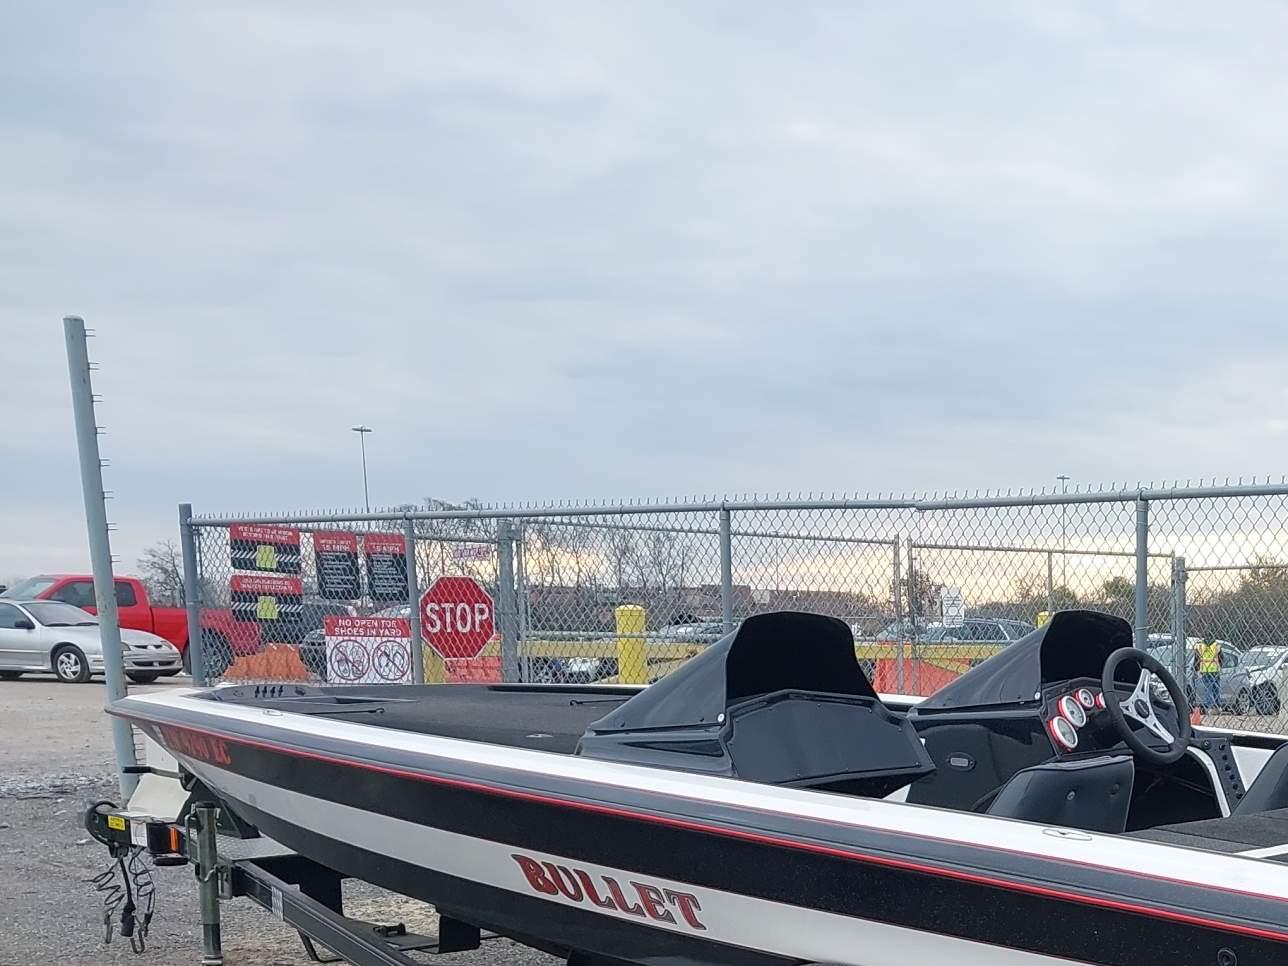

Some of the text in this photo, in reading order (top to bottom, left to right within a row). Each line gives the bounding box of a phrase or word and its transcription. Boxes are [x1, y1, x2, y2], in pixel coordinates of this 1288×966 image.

[338, 619, 397, 628] NO OPEN TOE
[425, 602, 490, 634] STOP
[334, 627, 401, 637] SHOES IN YARD
[511, 854, 707, 931] BULLET
